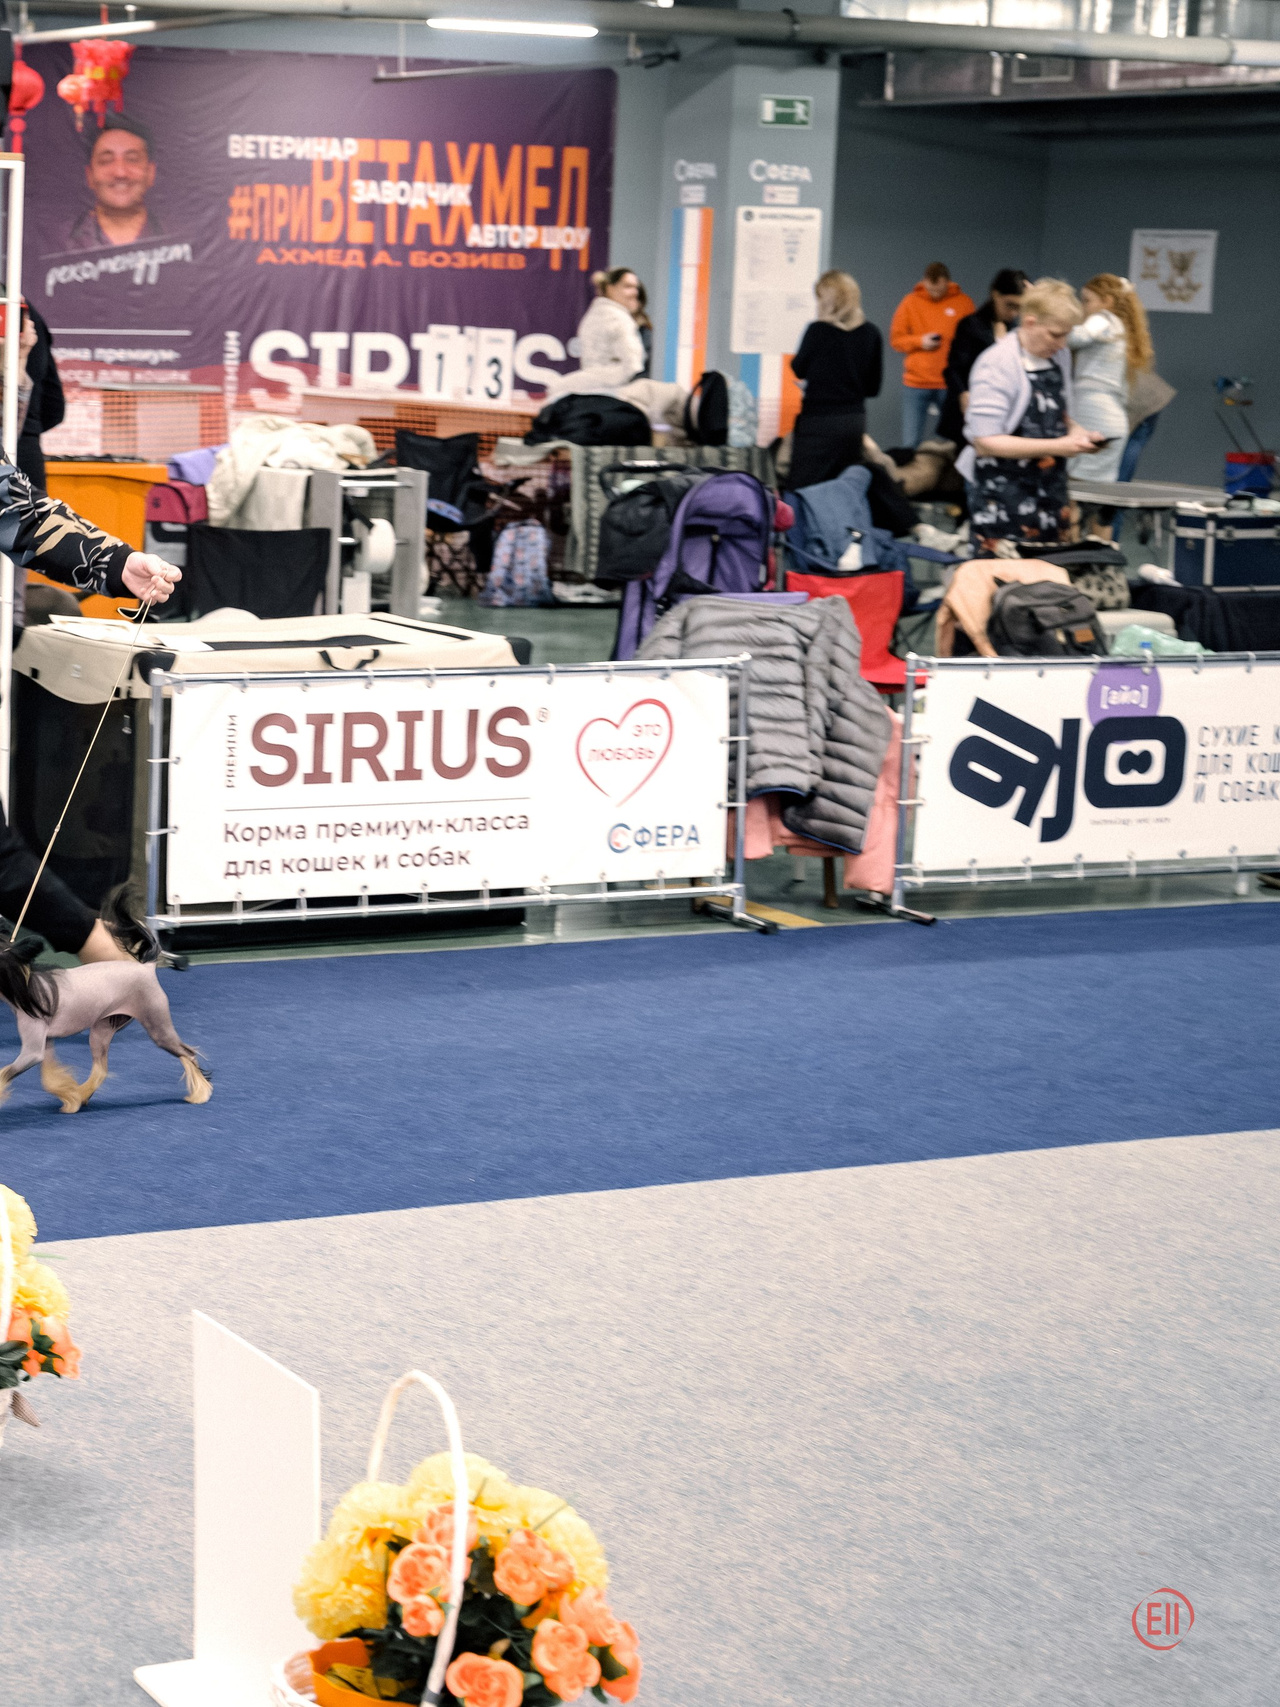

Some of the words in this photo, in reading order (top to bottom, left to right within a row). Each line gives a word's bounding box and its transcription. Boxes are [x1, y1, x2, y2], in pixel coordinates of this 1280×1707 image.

[228, 134, 358, 161] ВЕТЕРИНАР
[351, 180, 472, 210] ЗАВОДЧИК
[466, 224, 539, 248] АВТОР
[541, 226, 591, 250] ШОУ
[256, 247, 368, 269] АХМЕД
[371, 250, 403, 267] А.
[408, 250, 527, 271] БОЗИЕВ
[484, 356, 503, 400] 3
[1197, 724, 1261, 748] СУХИЕ
[1194, 753, 1233, 780] ДЛЯ
[1193, 782, 1207, 804] И
[223, 821, 307, 846] Корма
[316, 813, 531, 844] премиум-класса
[607, 822, 701, 854] СФЕРА
[223, 858, 272, 880] для
[281, 852, 366, 874] кошек
[373, 854, 389, 870] и
[398, 845, 472, 869] собак
